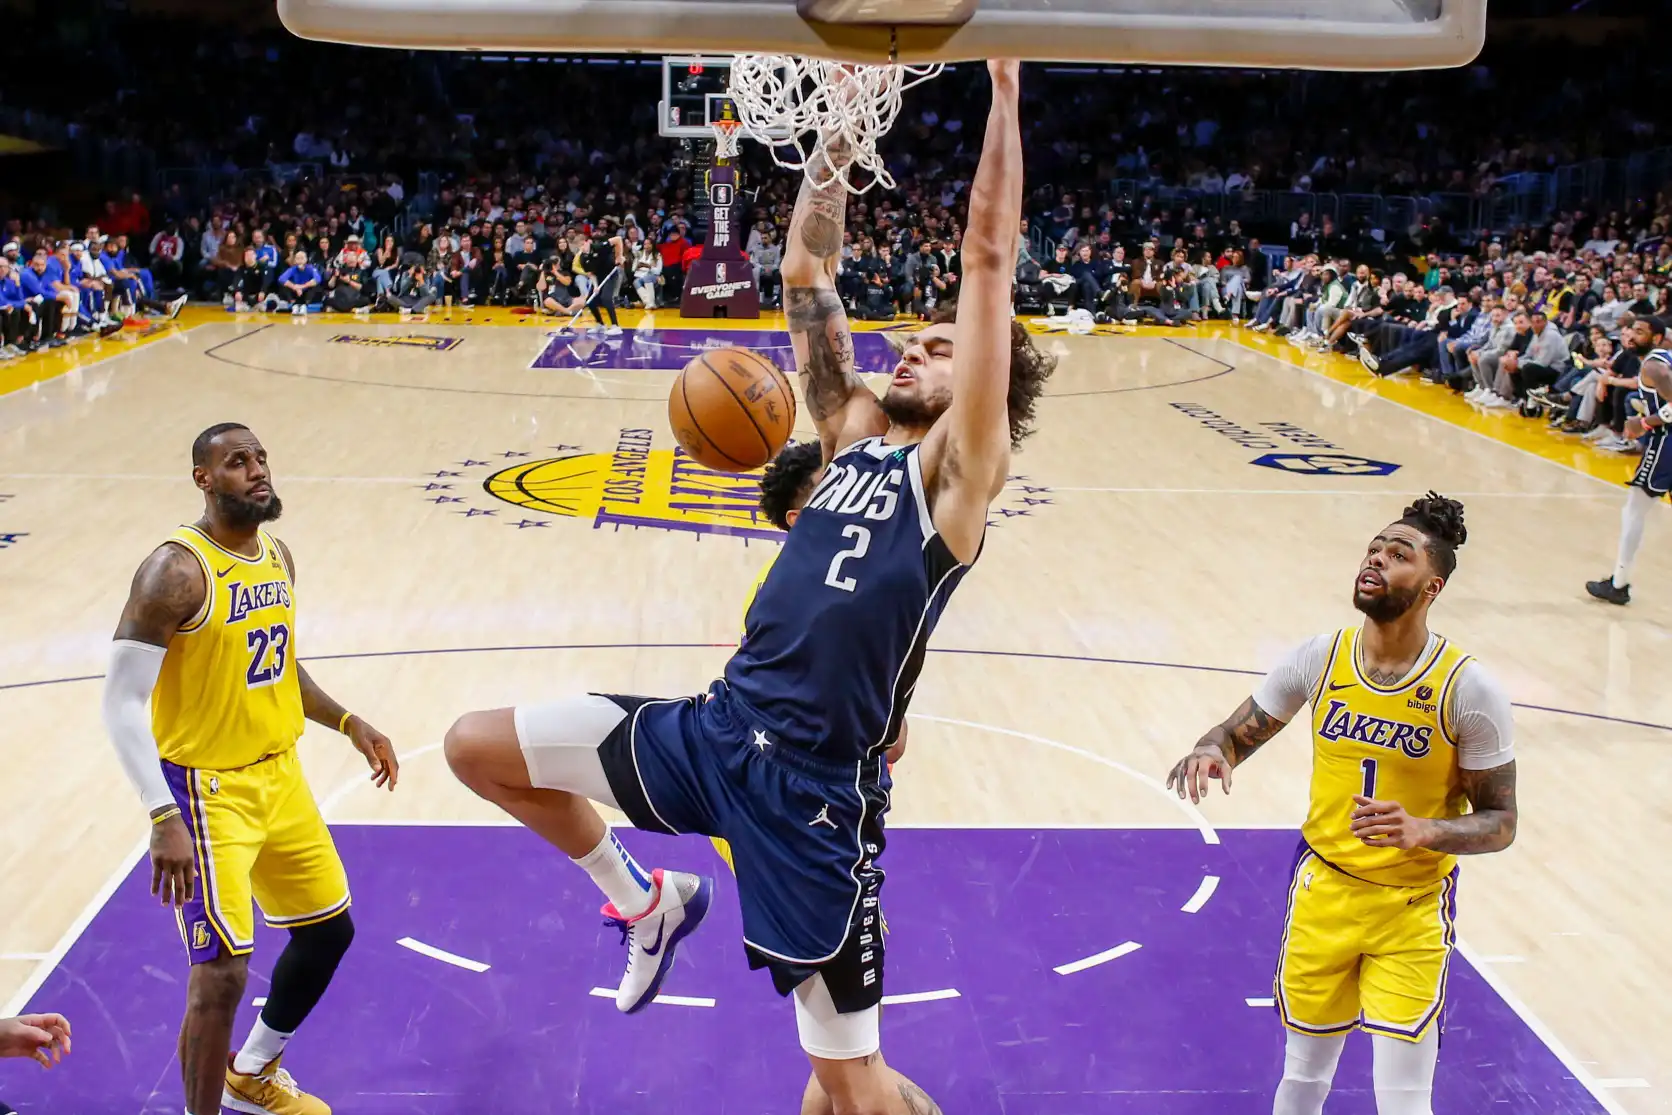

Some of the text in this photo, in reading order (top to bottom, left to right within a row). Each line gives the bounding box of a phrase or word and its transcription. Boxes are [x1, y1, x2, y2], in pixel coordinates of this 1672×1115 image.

[713, 220, 730, 233] THE
[714, 207, 730, 220] GET
[713, 234, 730, 247] APP
[706, 290, 735, 299] GAME
[602, 427, 653, 504] LOS ANGELES
[824, 524, 871, 592] 2
[225, 581, 291, 624] LAKERS
[246, 624, 290, 690] 23
[1407, 699, 1437, 713] bibigo
[1317, 699, 1434, 759] LAKERS
[1361, 758, 1378, 799] 1
